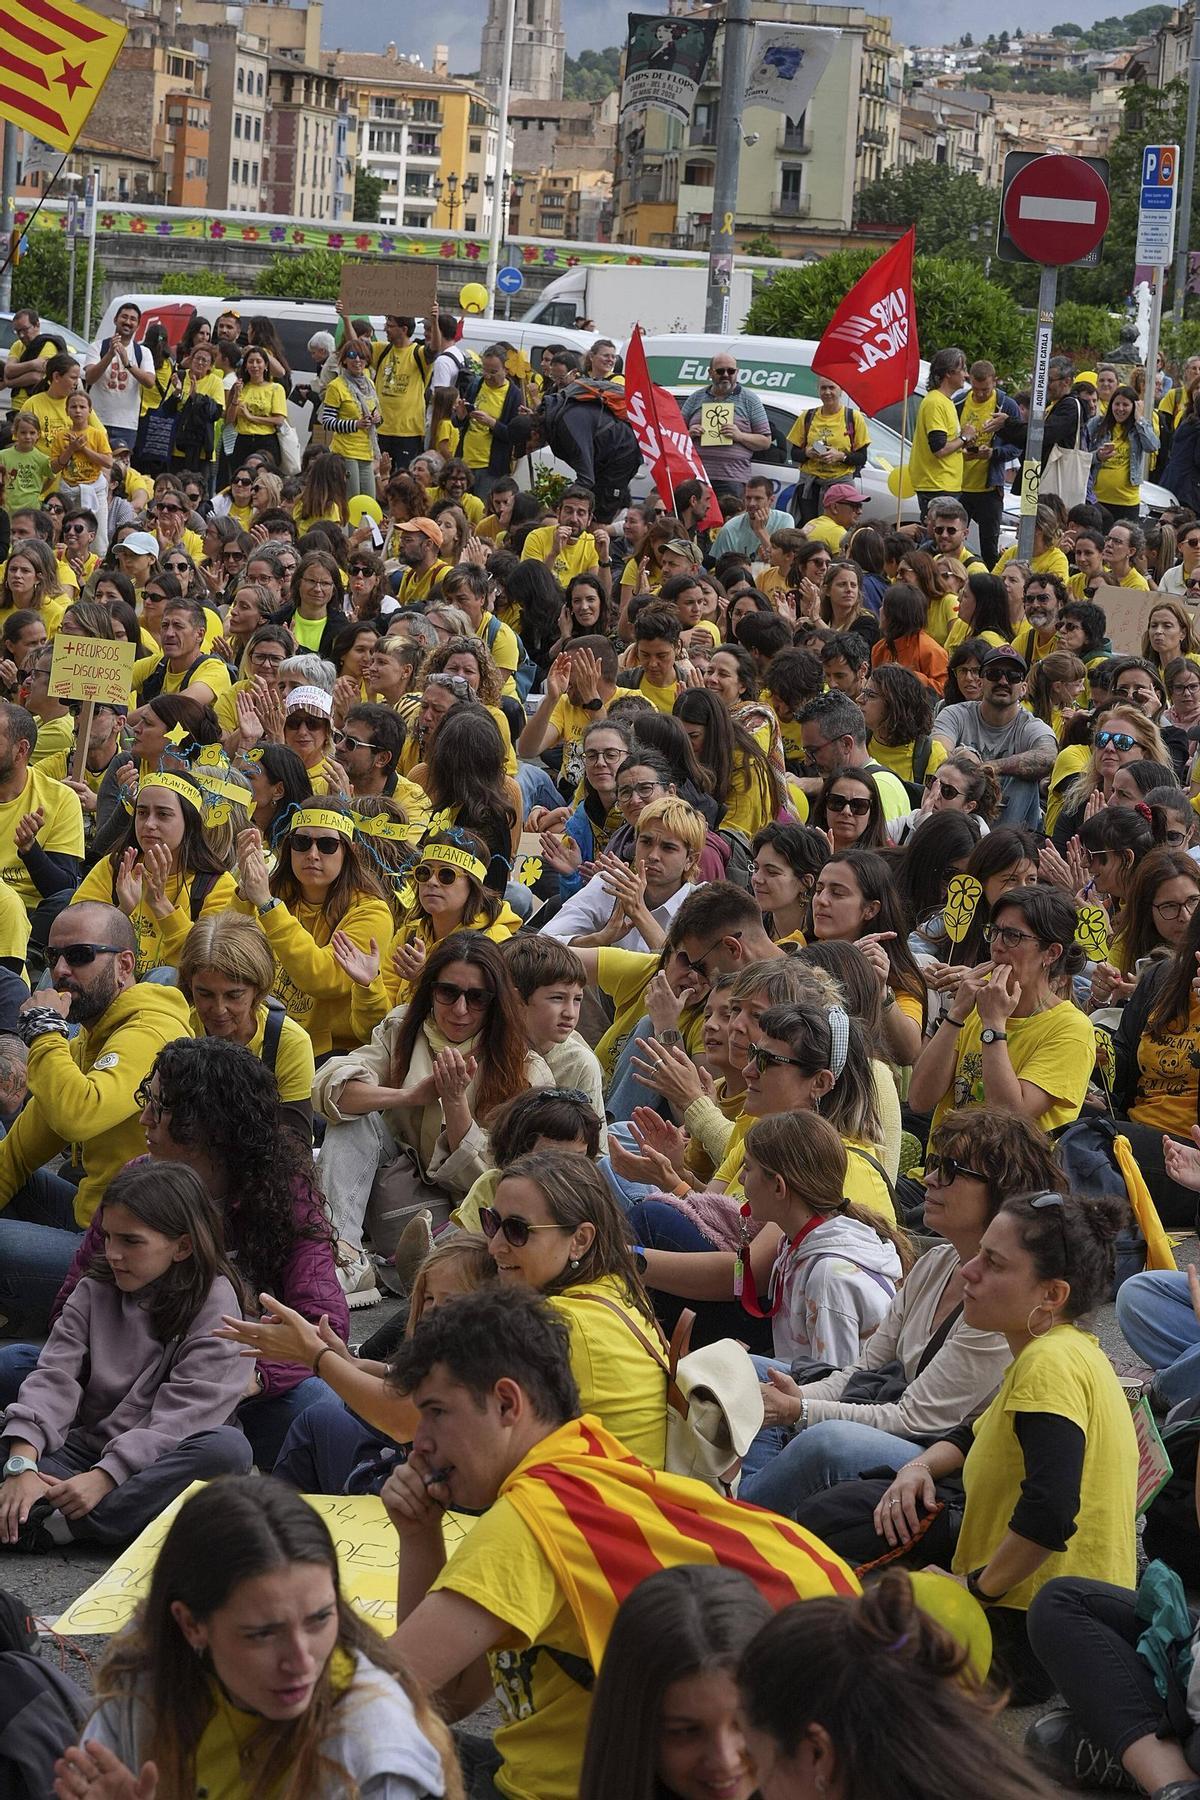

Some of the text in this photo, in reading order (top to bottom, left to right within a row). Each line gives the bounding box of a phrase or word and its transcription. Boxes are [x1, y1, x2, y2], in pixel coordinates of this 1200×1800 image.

[1146, 153, 1157, 180] P
[678, 359, 796, 389] Eupcar
[1037, 360, 1046, 389] PARLEM
[296, 814, 312, 825] ENS
